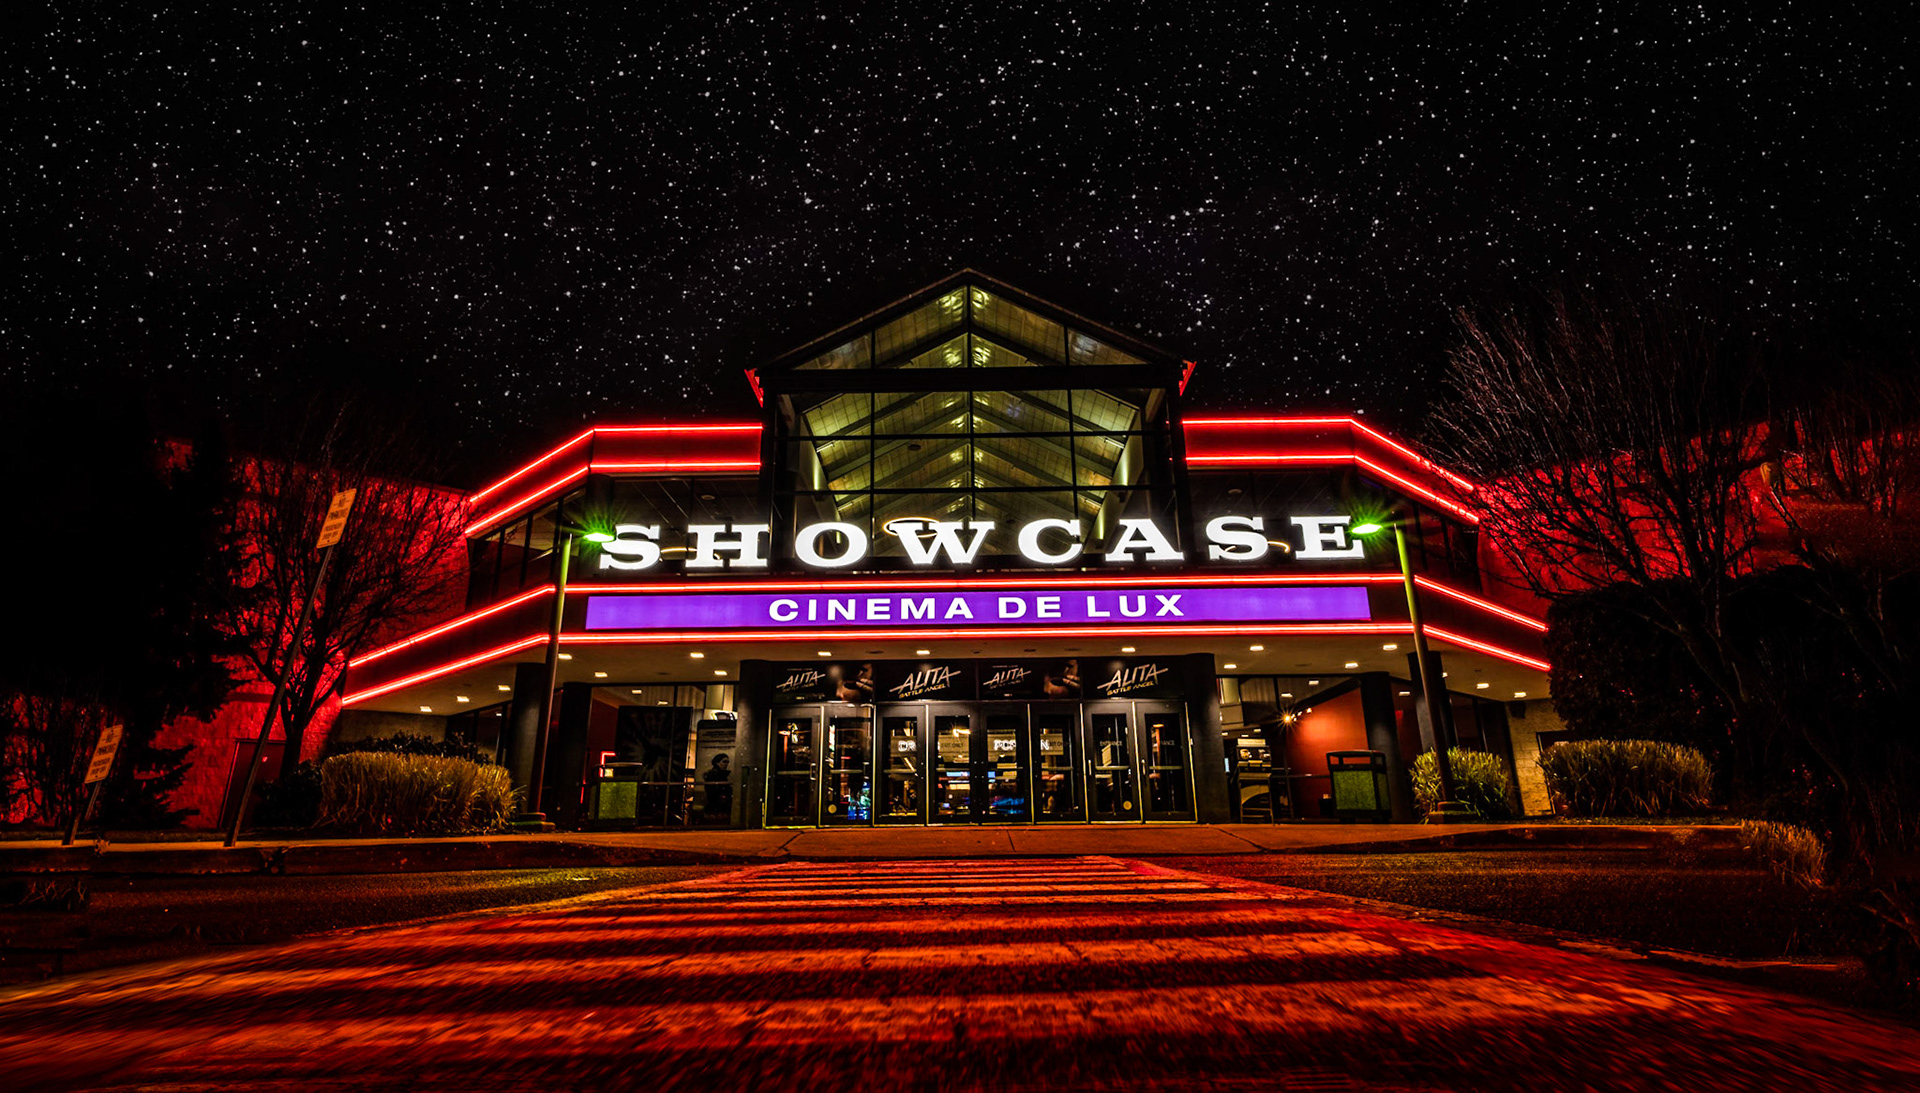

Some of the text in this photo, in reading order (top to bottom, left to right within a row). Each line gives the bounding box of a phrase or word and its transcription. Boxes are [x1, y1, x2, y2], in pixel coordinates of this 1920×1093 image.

[599, 515, 1365, 570] SHOWCASE
[769, 594, 1184, 621] CINEMA DE LUX
[775, 669, 826, 689] ALITA
[889, 665, 962, 693] ALITA
[982, 667, 1032, 686] ALITA
[1096, 663, 1169, 691] ALITA
[1107, 680, 1155, 696] BATTLE ANGEL
[898, 683, 947, 699] BATTLE ANGEL
